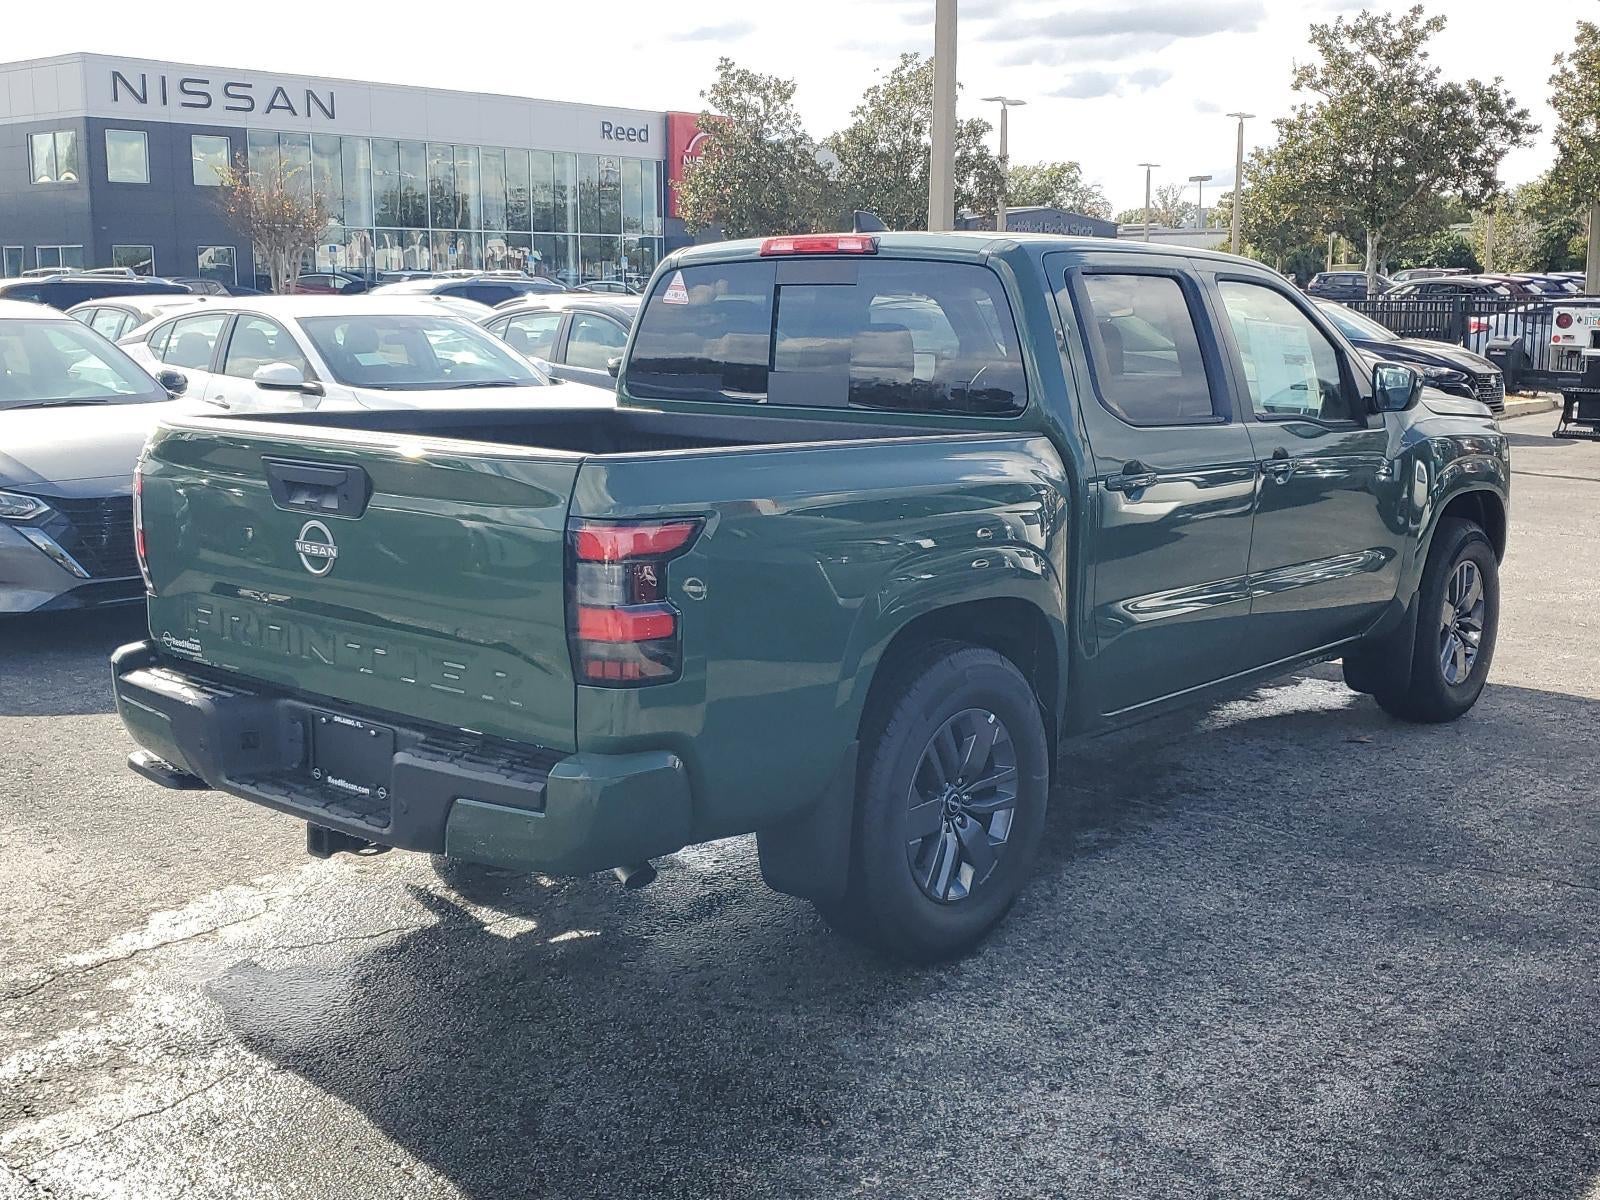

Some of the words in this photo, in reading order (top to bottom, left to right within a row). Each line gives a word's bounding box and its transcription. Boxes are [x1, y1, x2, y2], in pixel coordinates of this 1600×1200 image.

[111, 70, 336, 120] NISSAN
[601, 120, 649, 143] Reed
[295, 541, 337, 557] NISSAN
[185, 601, 526, 707] FRONTIER
[327, 775, 370, 795] ReedNissan.com
